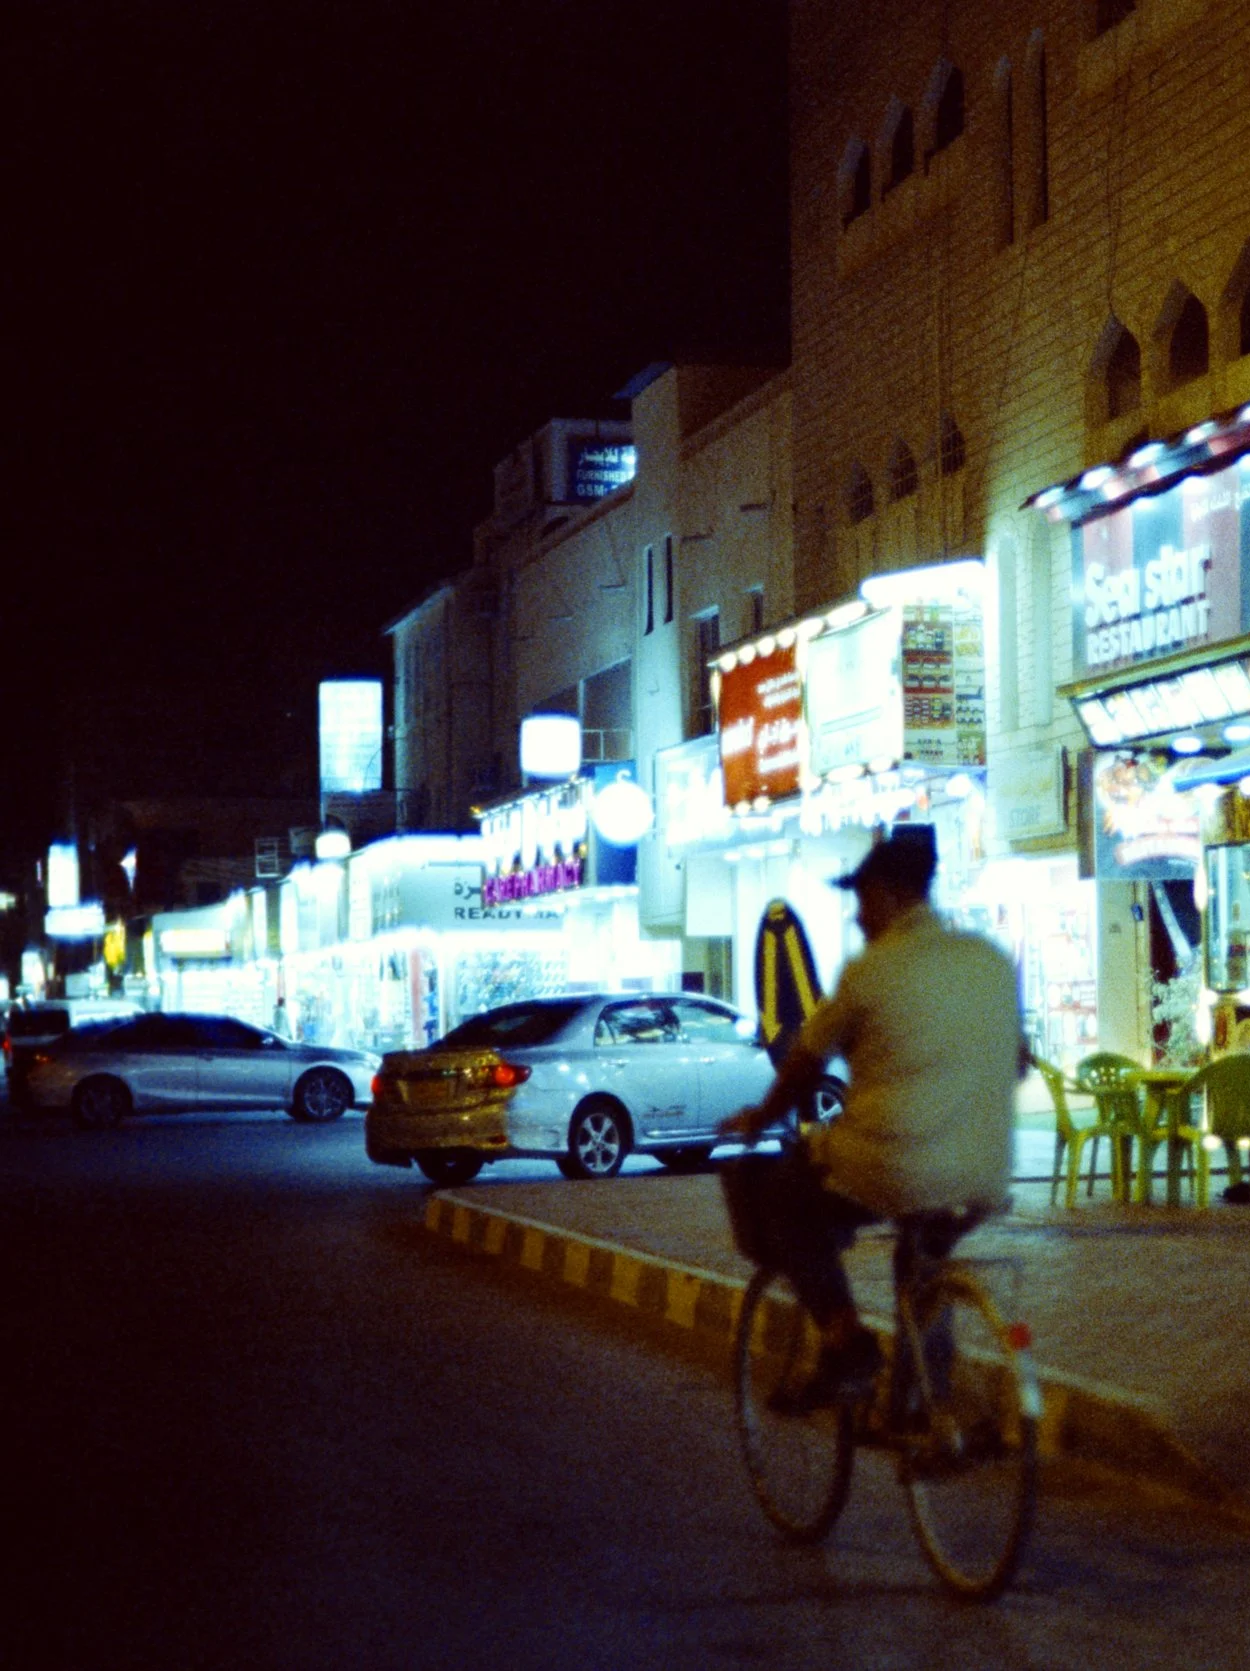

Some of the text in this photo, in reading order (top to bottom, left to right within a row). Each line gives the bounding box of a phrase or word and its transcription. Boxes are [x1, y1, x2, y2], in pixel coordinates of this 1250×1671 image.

[1085, 543, 1210, 628] Sea star
[1086, 600, 1211, 665] RESTAURANT
